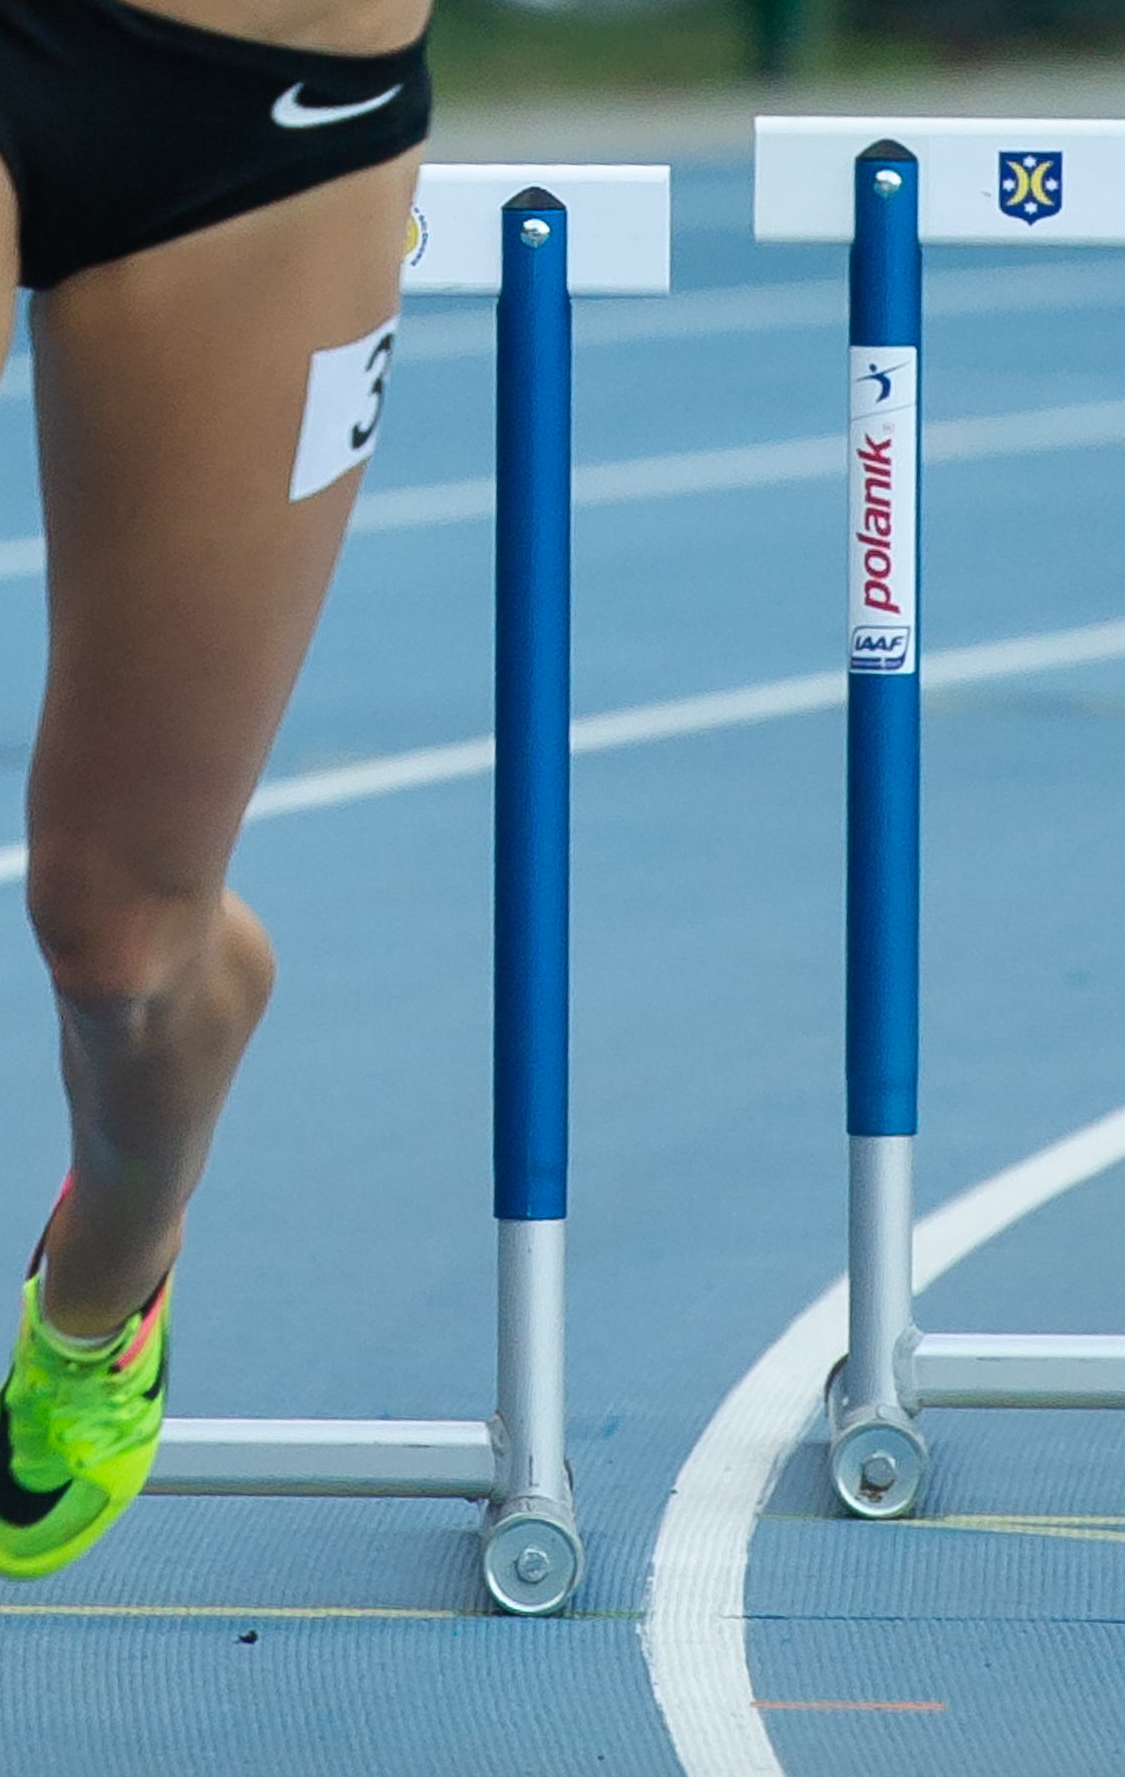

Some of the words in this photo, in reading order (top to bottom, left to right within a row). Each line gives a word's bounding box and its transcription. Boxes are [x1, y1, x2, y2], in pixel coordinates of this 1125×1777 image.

[351, 332, 395, 450] 3
[856, 432, 902, 615] polanik
[855, 634, 905, 652] IAAF
